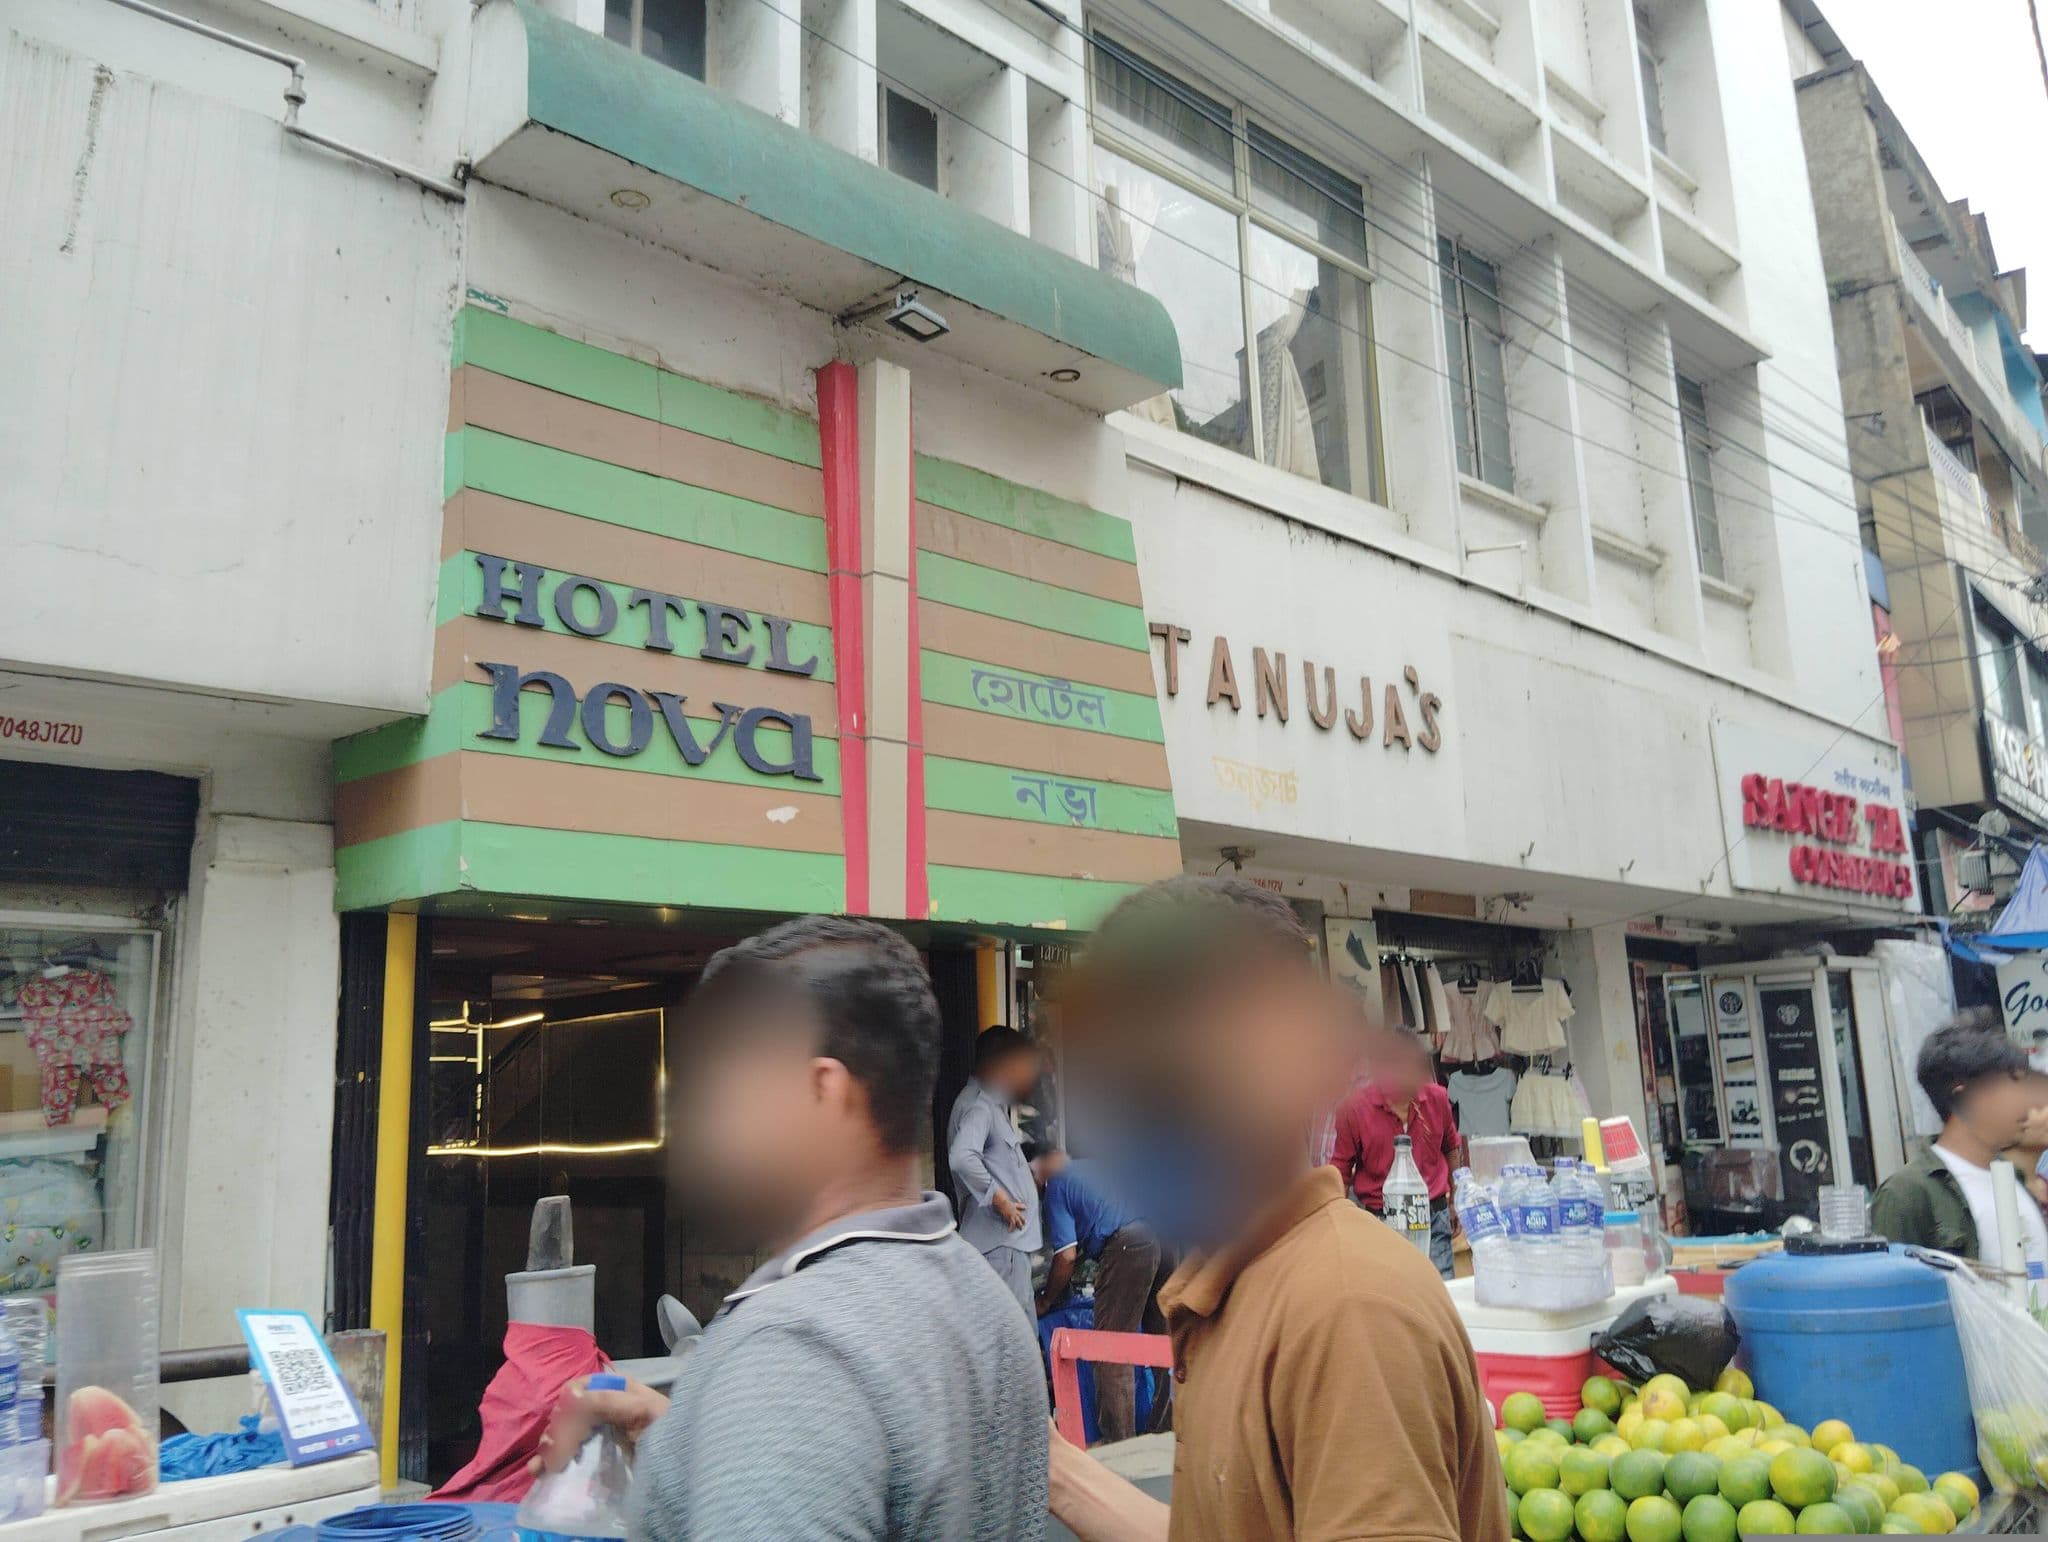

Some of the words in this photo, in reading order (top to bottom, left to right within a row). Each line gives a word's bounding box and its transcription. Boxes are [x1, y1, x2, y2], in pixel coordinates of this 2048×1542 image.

[476, 554, 818, 676] HOTEL
[971, 668, 1106, 729] হোটেল
[1149, 622, 1442, 753] TANUJA'S
[2005, 980, 2048, 1026] Go
